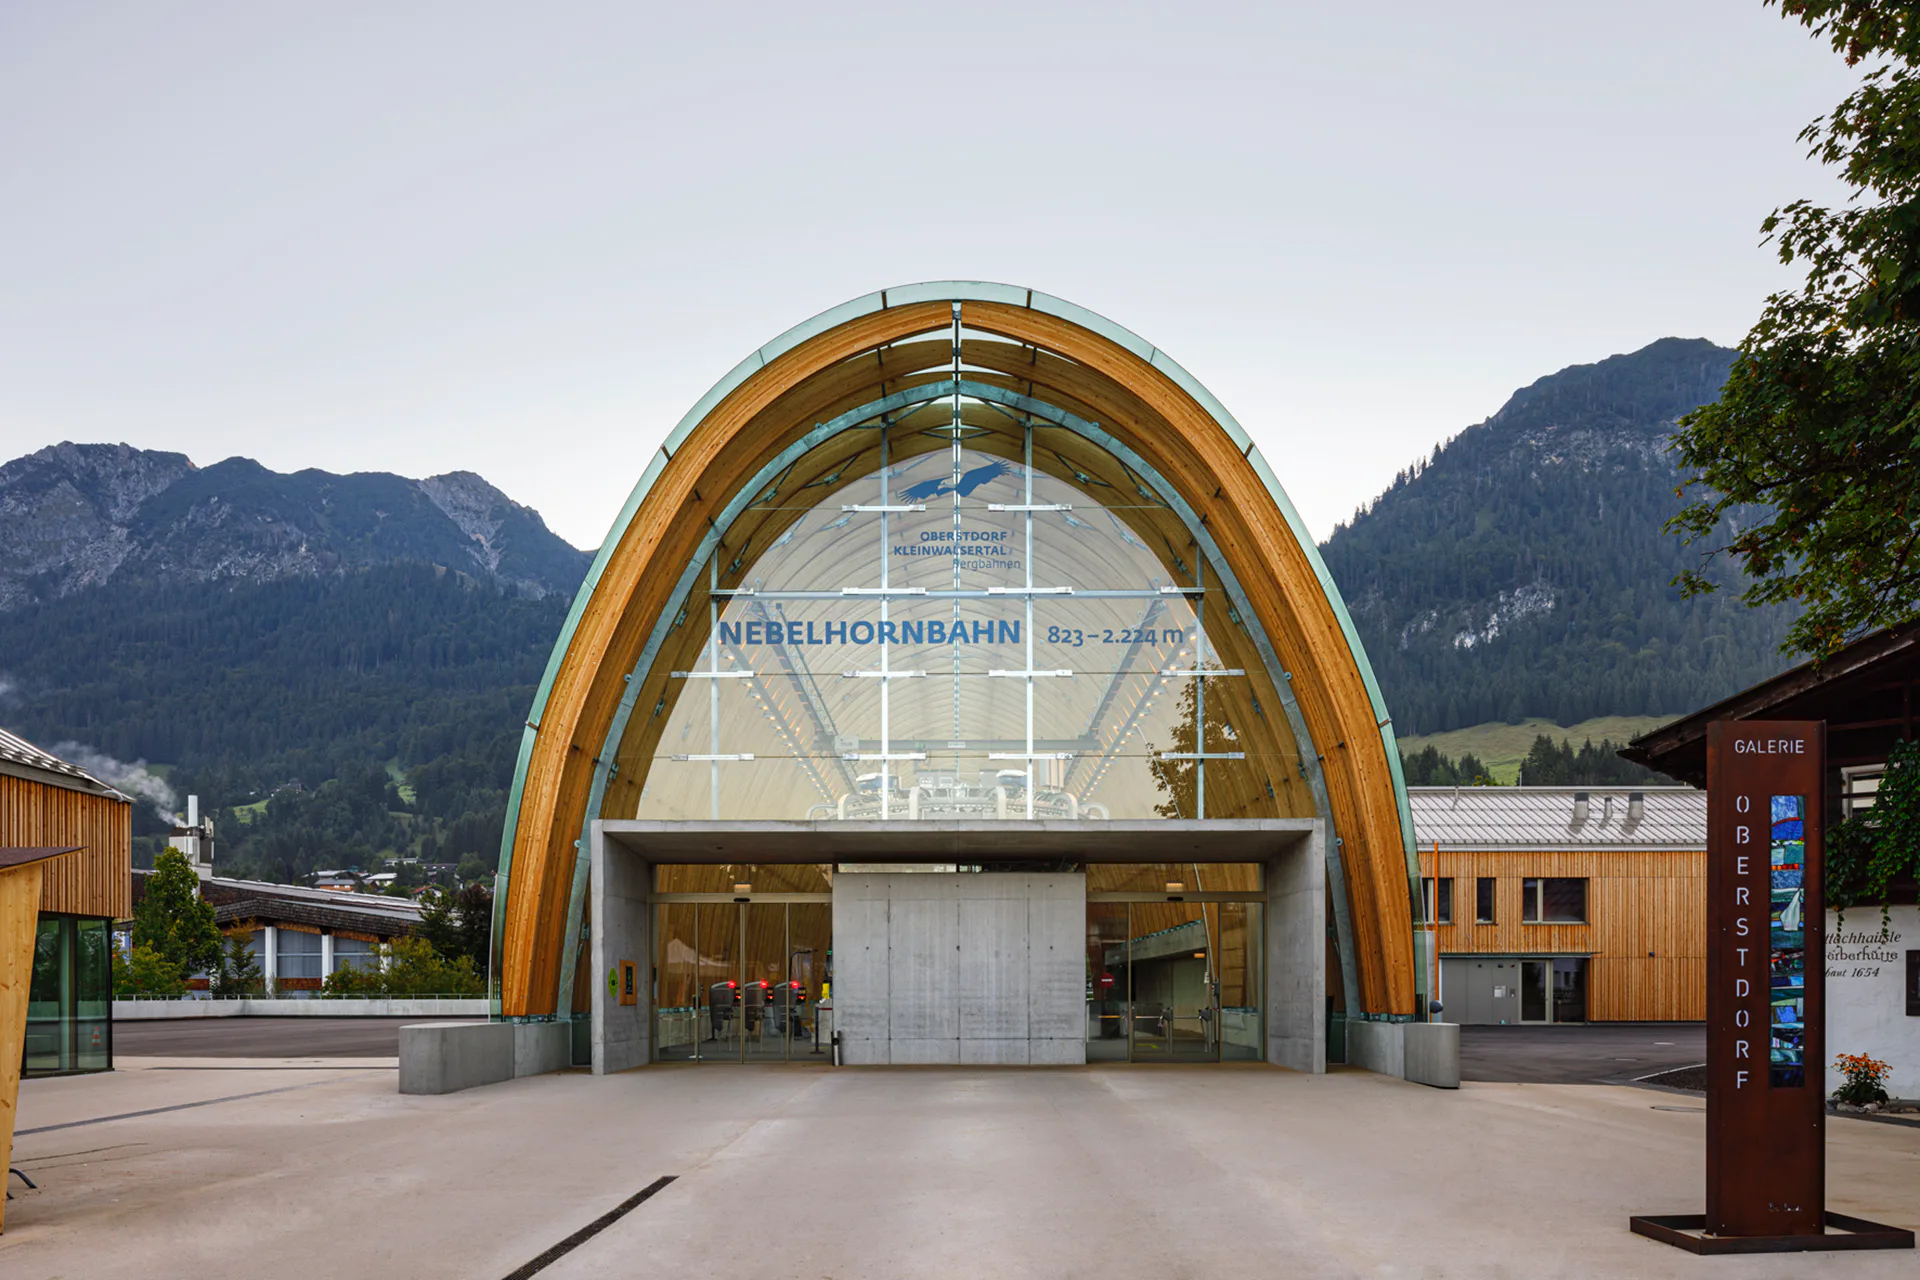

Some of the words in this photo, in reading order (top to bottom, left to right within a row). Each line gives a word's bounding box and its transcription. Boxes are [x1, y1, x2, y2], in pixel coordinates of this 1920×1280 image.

[920, 531, 1008, 541] OBERSTDORF
[894, 545, 1007, 556] KLEINWALSERTAL
[953, 559, 1021, 571] Bergbahnen
[719, 620, 1020, 645] NEBELHORNBAHN
[1163, 629, 1184, 643] m
[1734, 739, 1805, 754] GALERIE
[1736, 795, 1750, 1089] OBERSTDORF
[1825, 966, 1847, 978] baut
[1851, 967, 1880, 978] 1654
